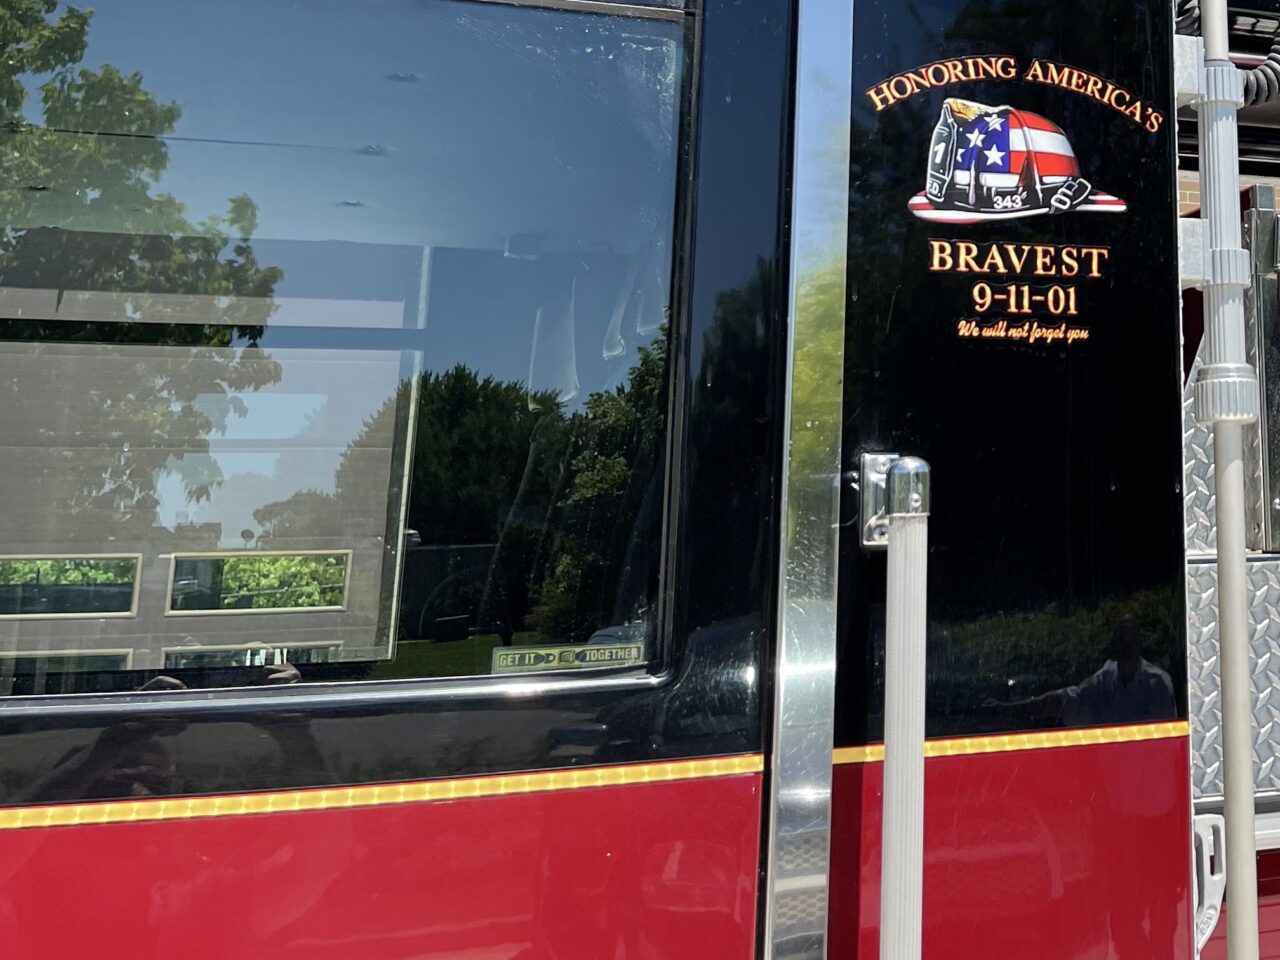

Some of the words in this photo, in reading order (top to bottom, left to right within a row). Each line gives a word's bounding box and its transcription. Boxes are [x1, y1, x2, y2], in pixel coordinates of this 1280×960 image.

[865, 57, 1017, 111] HONORING
[1025, 60, 1163, 133] AMERICA'S
[934, 142, 946, 164] 1
[993, 195, 1022, 209] 343
[929, 240, 1108, 277] BRAVEST
[972, 282, 1078, 314] 9-11-01
[958, 319, 980, 337] We
[982, 321, 1007, 338] will
[1008, 321, 1029, 338] not
[1029, 322, 1066, 343] forget
[1066, 331, 1090, 343] you
[500, 655, 520, 666] GET
[525, 653, 535, 664] IT
